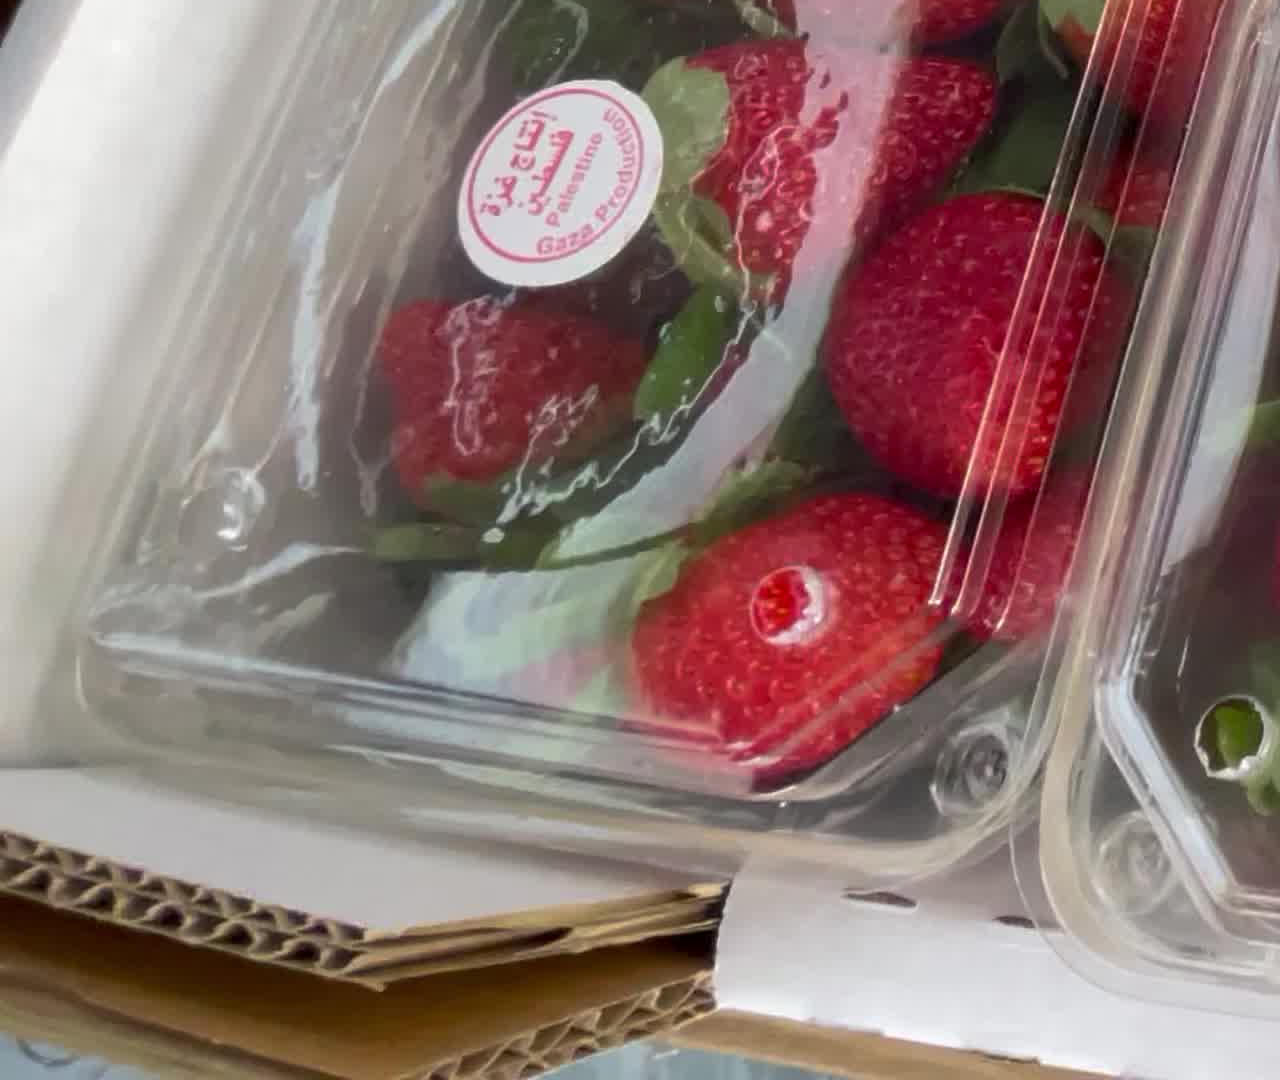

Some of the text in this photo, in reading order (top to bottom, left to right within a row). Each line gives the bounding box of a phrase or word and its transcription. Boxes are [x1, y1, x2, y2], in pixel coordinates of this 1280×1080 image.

[479, 110, 557, 216] إنتاج غزة
[516, 130, 574, 216] فلسطين
[536, 108, 633, 255] Gaza Production
